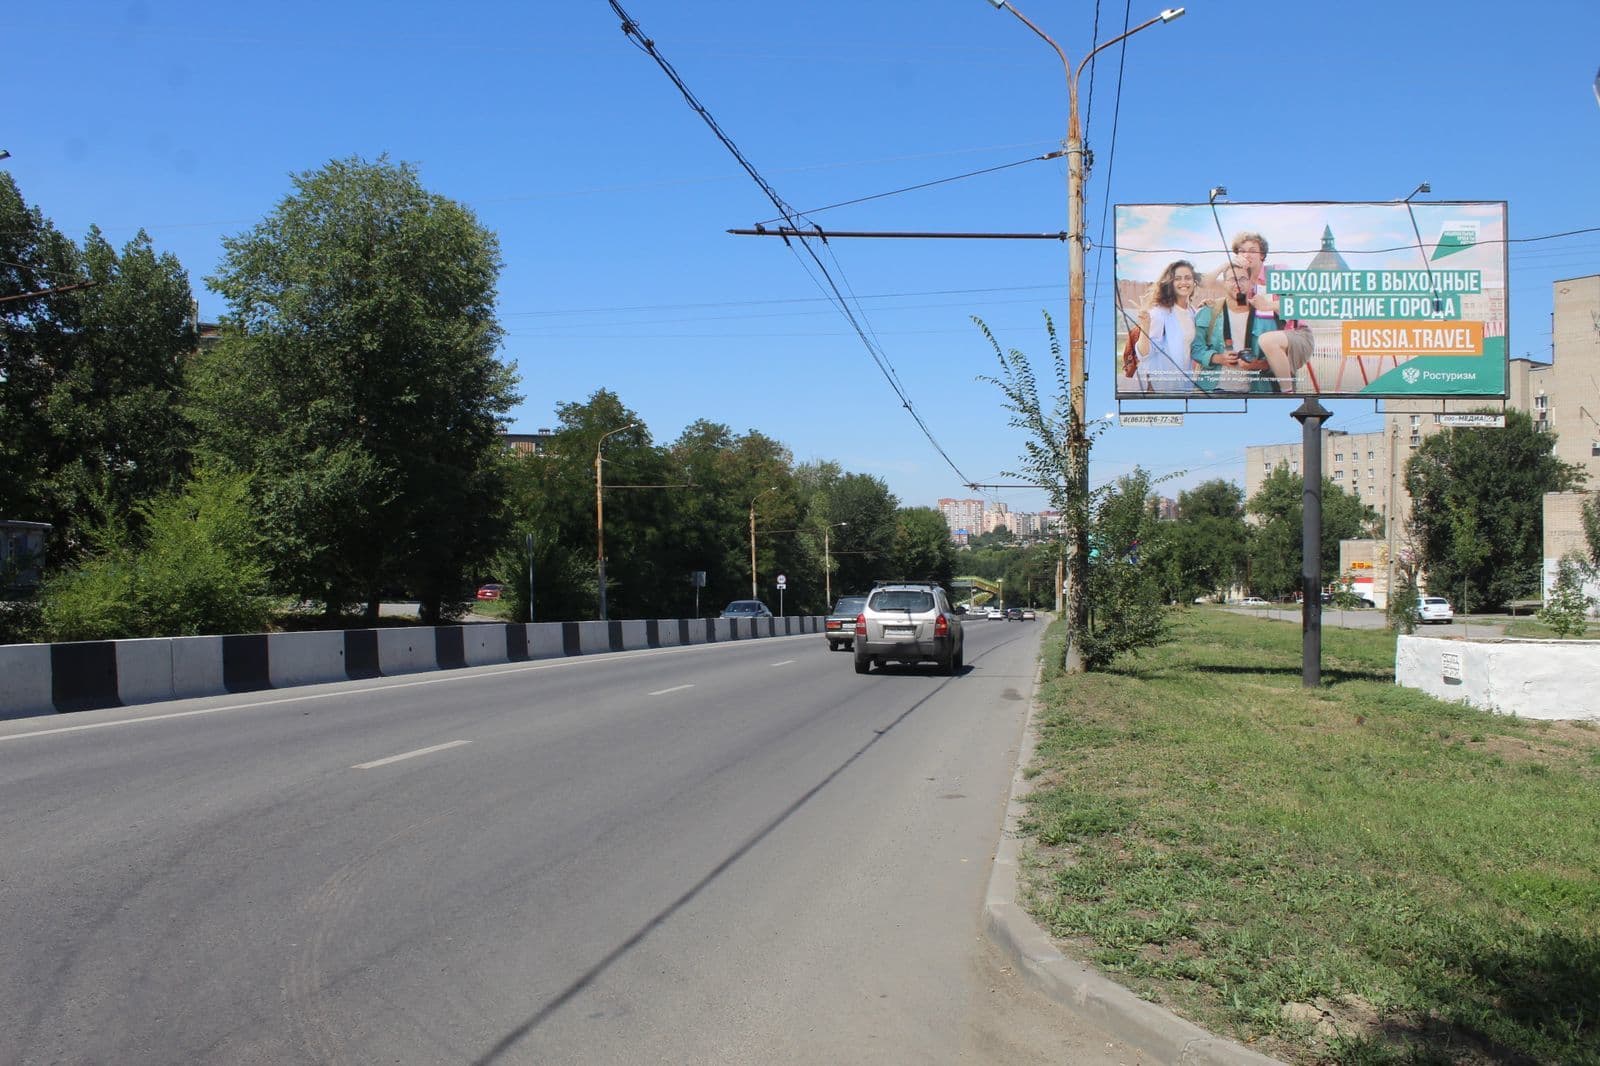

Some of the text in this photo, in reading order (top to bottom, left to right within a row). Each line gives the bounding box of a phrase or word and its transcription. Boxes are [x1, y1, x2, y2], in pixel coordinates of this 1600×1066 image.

[1270, 272, 1479, 293] ВЫХОДИТЕ В ВЫХОДНЫЕ
[1284, 298, 1294, 316] В
[1300, 298, 1385, 318] СОСЕДНИЕ
[1350, 328, 1475, 349] RUSSIA.TRAVEL
[1423, 371, 1476, 381] Ростуризм
